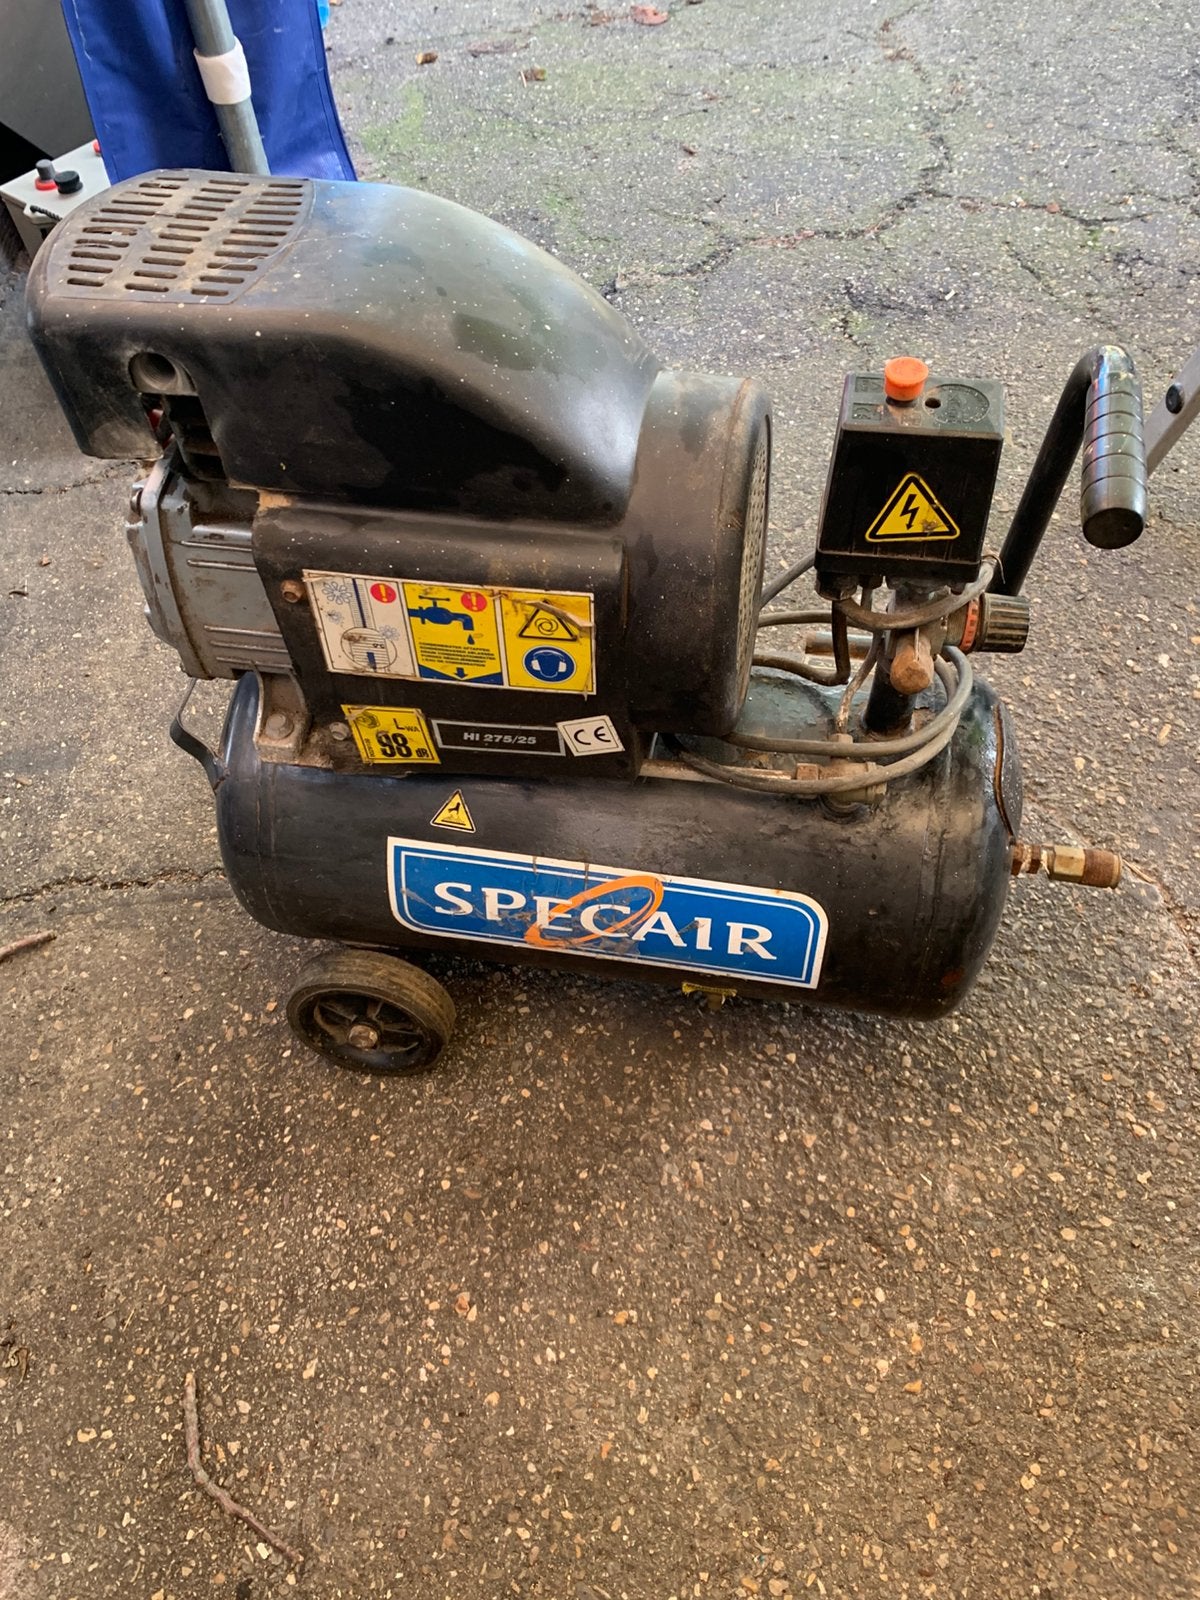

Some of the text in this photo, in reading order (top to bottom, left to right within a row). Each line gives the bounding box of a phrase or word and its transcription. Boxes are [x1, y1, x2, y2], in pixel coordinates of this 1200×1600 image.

[377, 730, 413, 758] 98
[463, 732, 537, 745] HI 275/25
[574, 725, 611, 746] CE
[434, 881, 777, 961] SPECAIR
